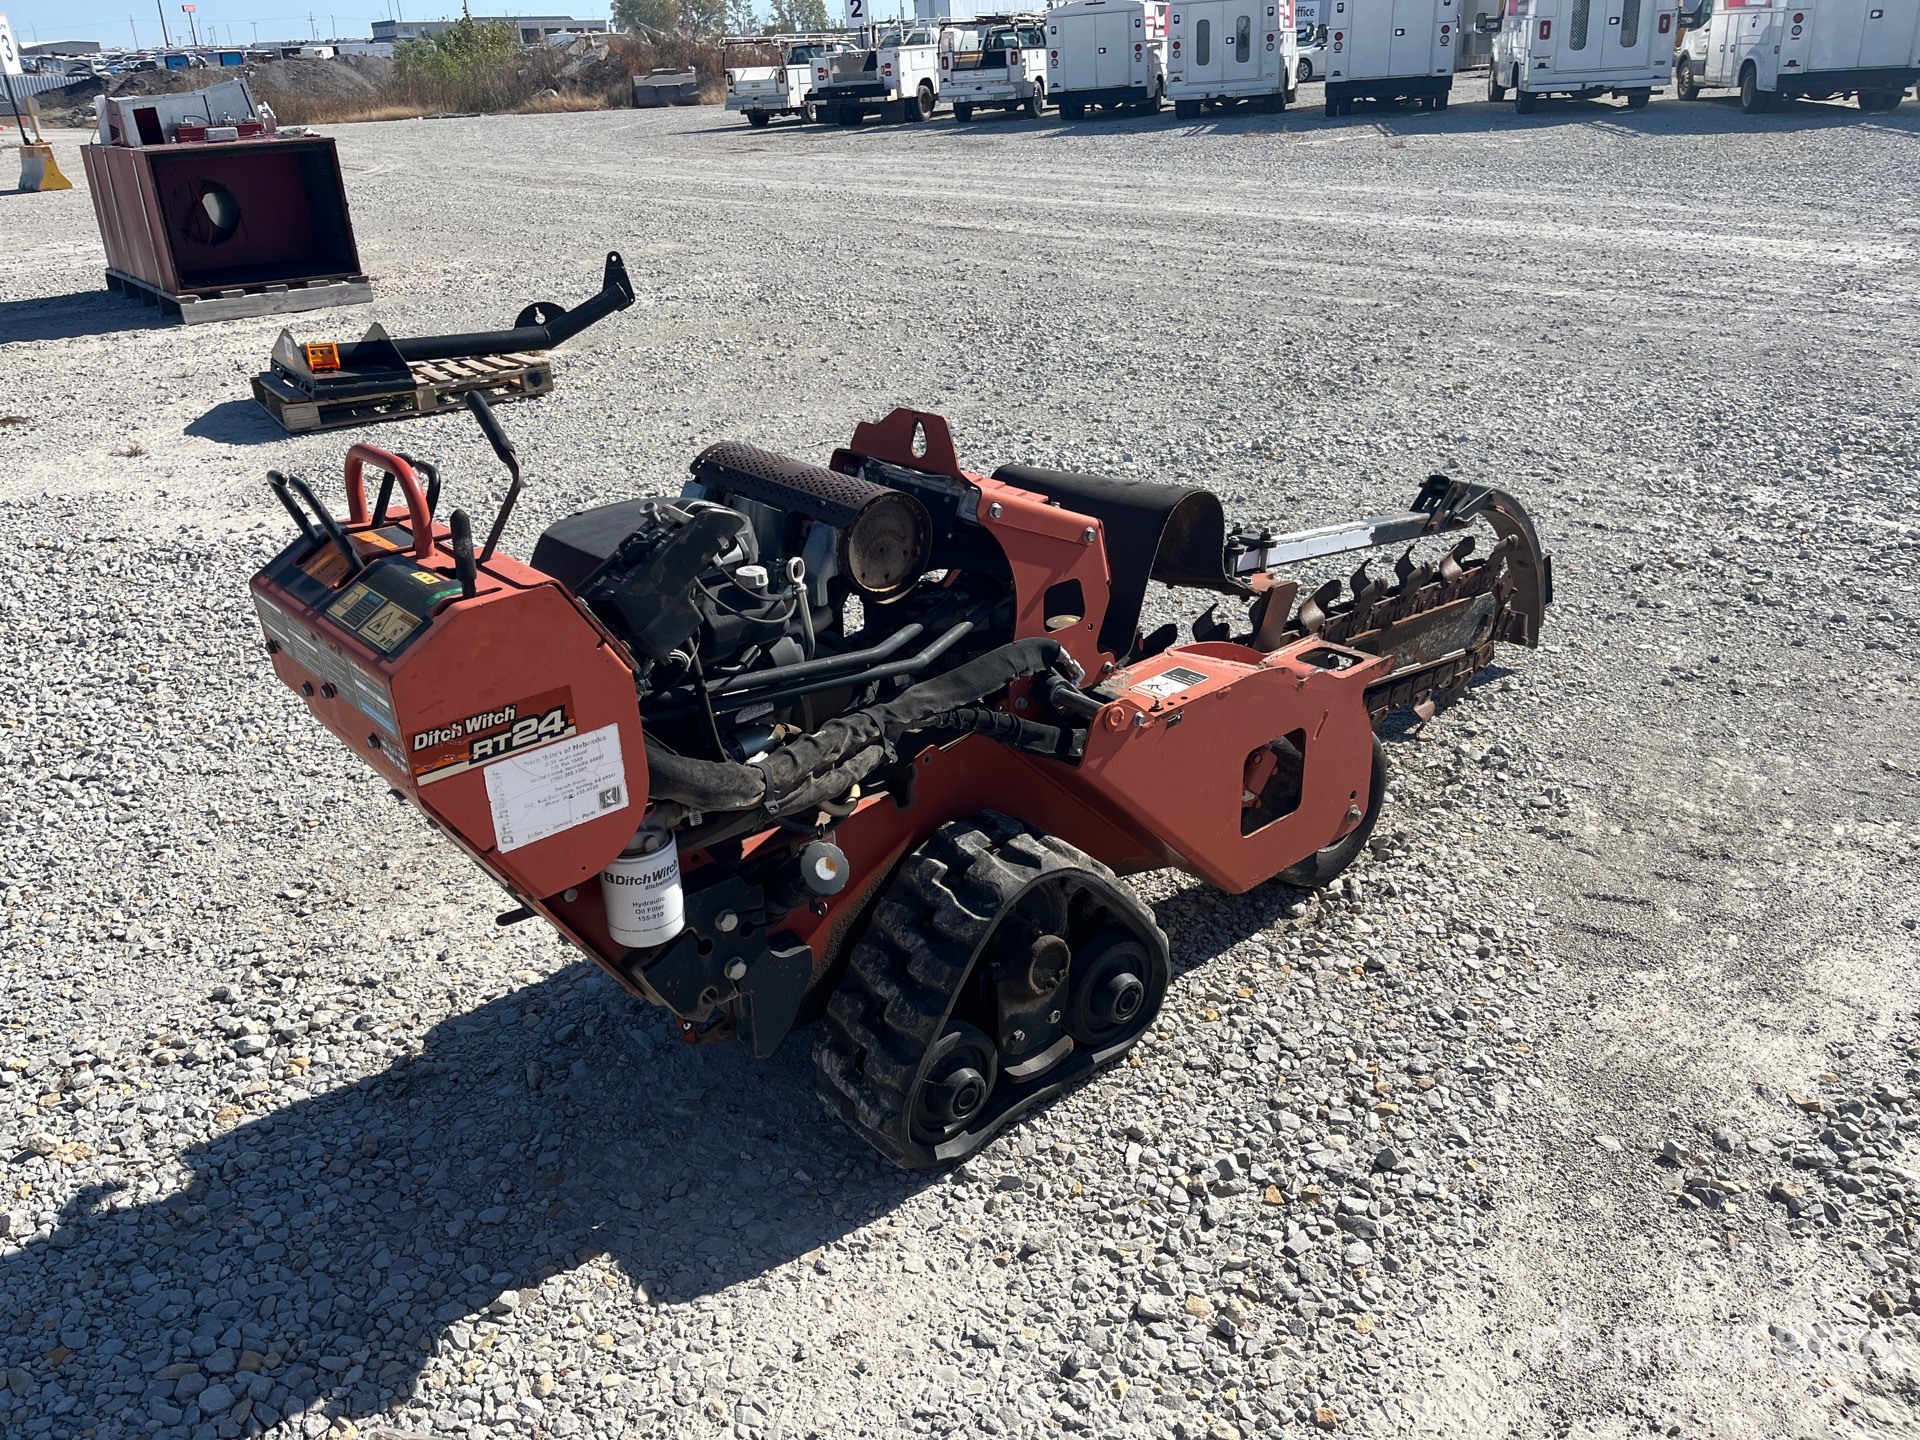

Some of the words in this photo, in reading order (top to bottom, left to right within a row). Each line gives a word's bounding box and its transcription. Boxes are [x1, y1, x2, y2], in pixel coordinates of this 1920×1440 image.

[849, 0, 863, 18] 2
[1295, 6, 1315, 17] ffice
[1, 34, 14, 62] 3
[413, 723, 463, 751] Ditch
[465, 705, 515, 734] Witch
[473, 710, 565, 760] RT24
[564, 746, 571, 754] of
[573, 735, 607, 751] Nebraska
[616, 873, 652, 886] Ditch
[653, 858, 678, 882] Witch
[632, 895, 665, 909] Hydraulic
[635, 908, 646, 917] Oil
[647, 902, 665, 914] Filter
[638, 911, 665, 923] 155-910
